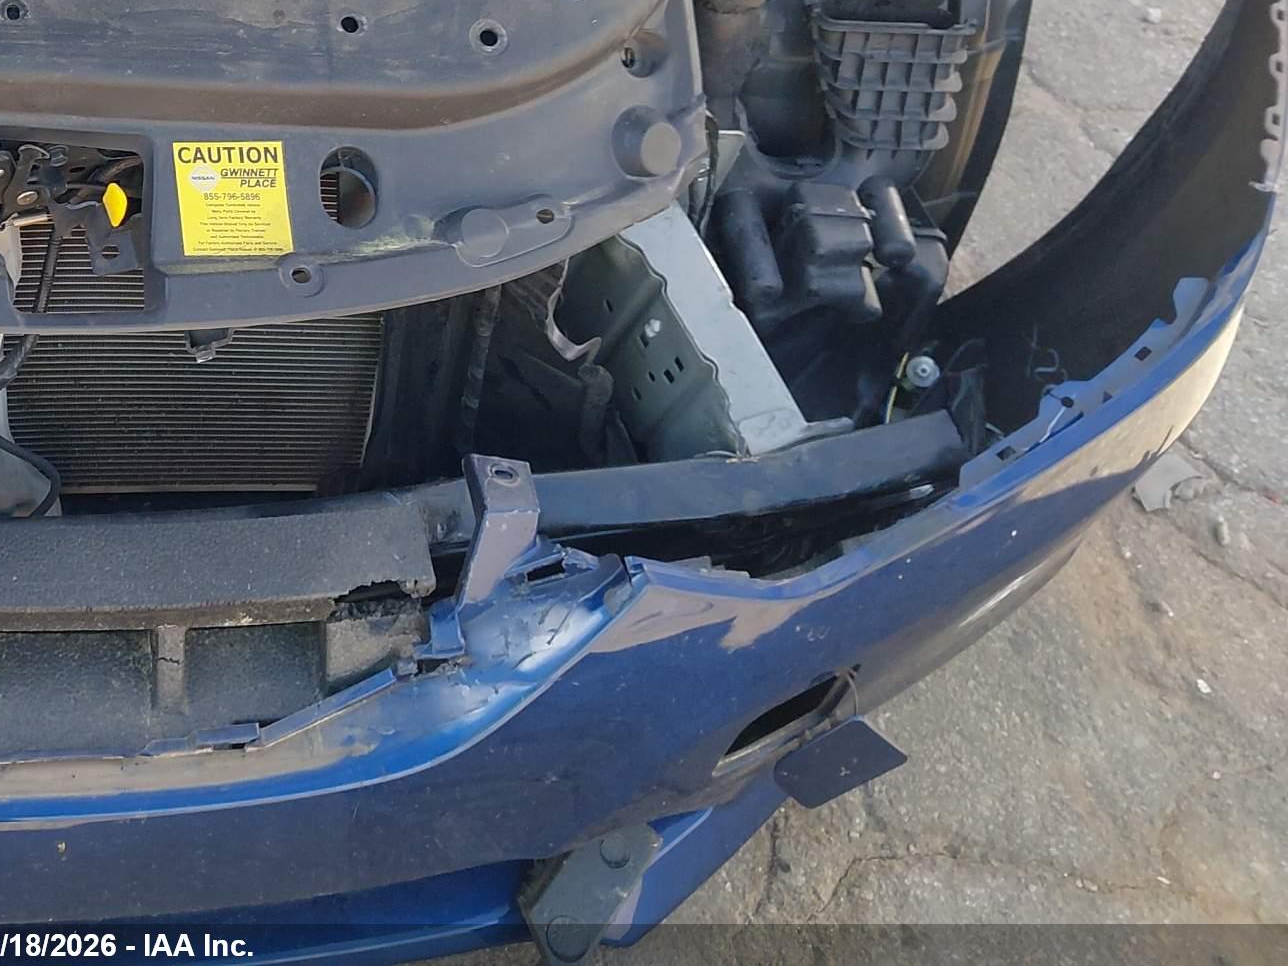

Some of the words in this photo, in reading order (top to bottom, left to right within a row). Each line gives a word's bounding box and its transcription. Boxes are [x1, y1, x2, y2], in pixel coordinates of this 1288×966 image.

[177, 146, 279, 164] CAUTION
[220, 168, 279, 177] GWINNETT
[240, 179, 277, 188] PLACE
[203, 193, 261, 201] 855-796-5896
